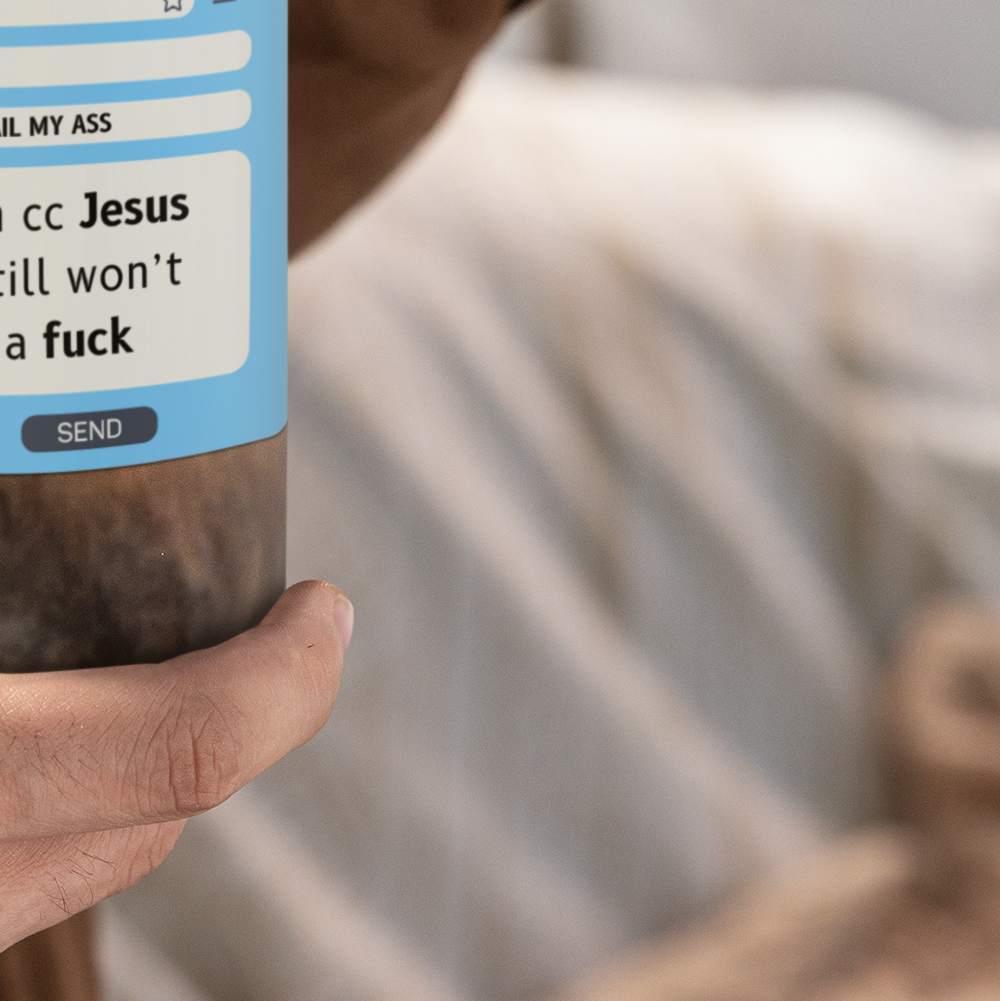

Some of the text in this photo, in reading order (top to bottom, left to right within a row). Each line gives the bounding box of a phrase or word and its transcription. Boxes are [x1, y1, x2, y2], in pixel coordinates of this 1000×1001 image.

[29, 115, 64, 137] MY
[71, 112, 112, 135] ASS
[22, 202, 64, 232] cc
[79, 191, 190, 229] Jesus
[66, 252, 182, 294] won’t
[5, 332, 26, 361] a
[42, 315, 134, 359] fuck
[57, 418, 122, 444] SEND
